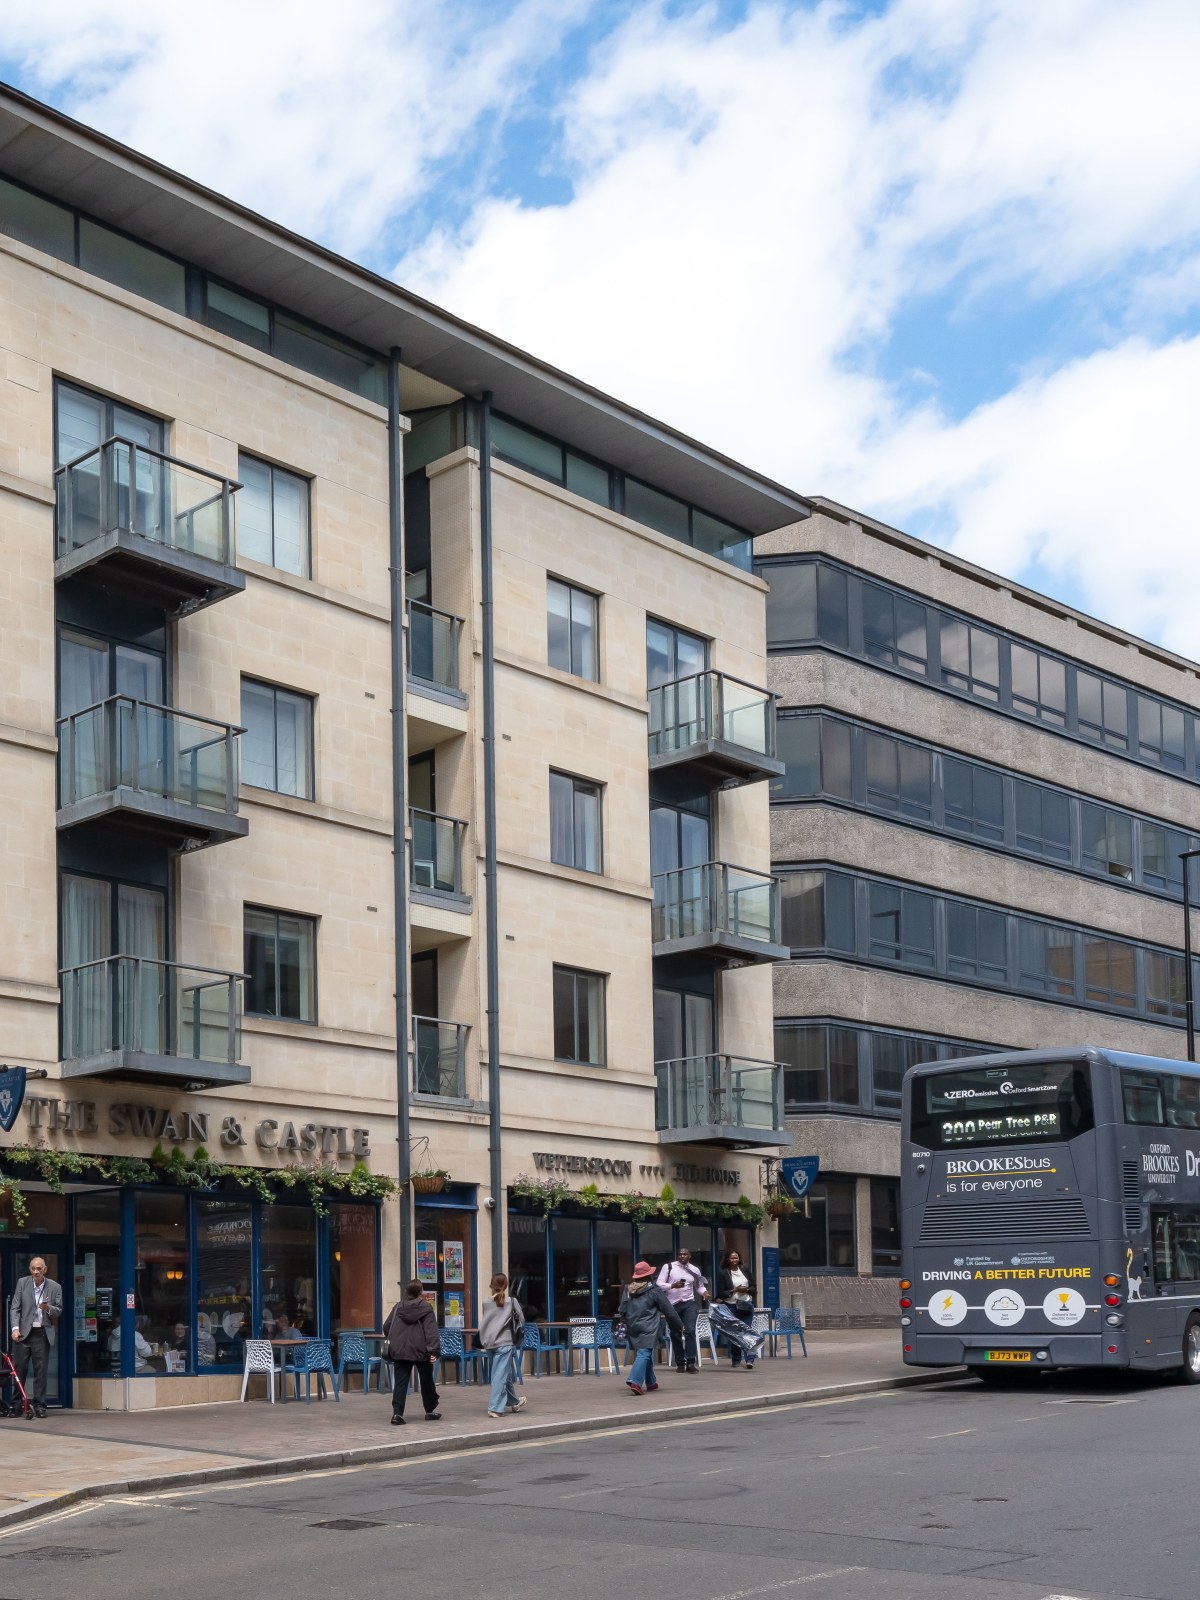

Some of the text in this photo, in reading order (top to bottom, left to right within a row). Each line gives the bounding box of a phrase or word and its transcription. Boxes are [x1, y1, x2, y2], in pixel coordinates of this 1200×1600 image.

[26, 1095, 372, 1157] THE SWAN & CASTLE
[978, 1119, 1002, 1131] Pear
[1006, 1117, 1031, 1128] Tree
[1034, 1113, 1057, 1126] P&R
[1149, 1143, 1171, 1154] OXFORD
[532, 1152, 632, 1176] WETHERSPOON
[946, 1156, 1051, 1174] BROOKESbus
[1142, 1154, 1180, 1173] BROOKES
[1185, 1149, 1200, 1177] Dr
[946, 1178, 1043, 1193] is for everyone
[1147, 1173, 1176, 1184] UNIVERSITY
[922, 1268, 1091, 1281] DRIVING A BETTER FUTURE
[989, 1352, 1029, 1360] BJ73 WWP
